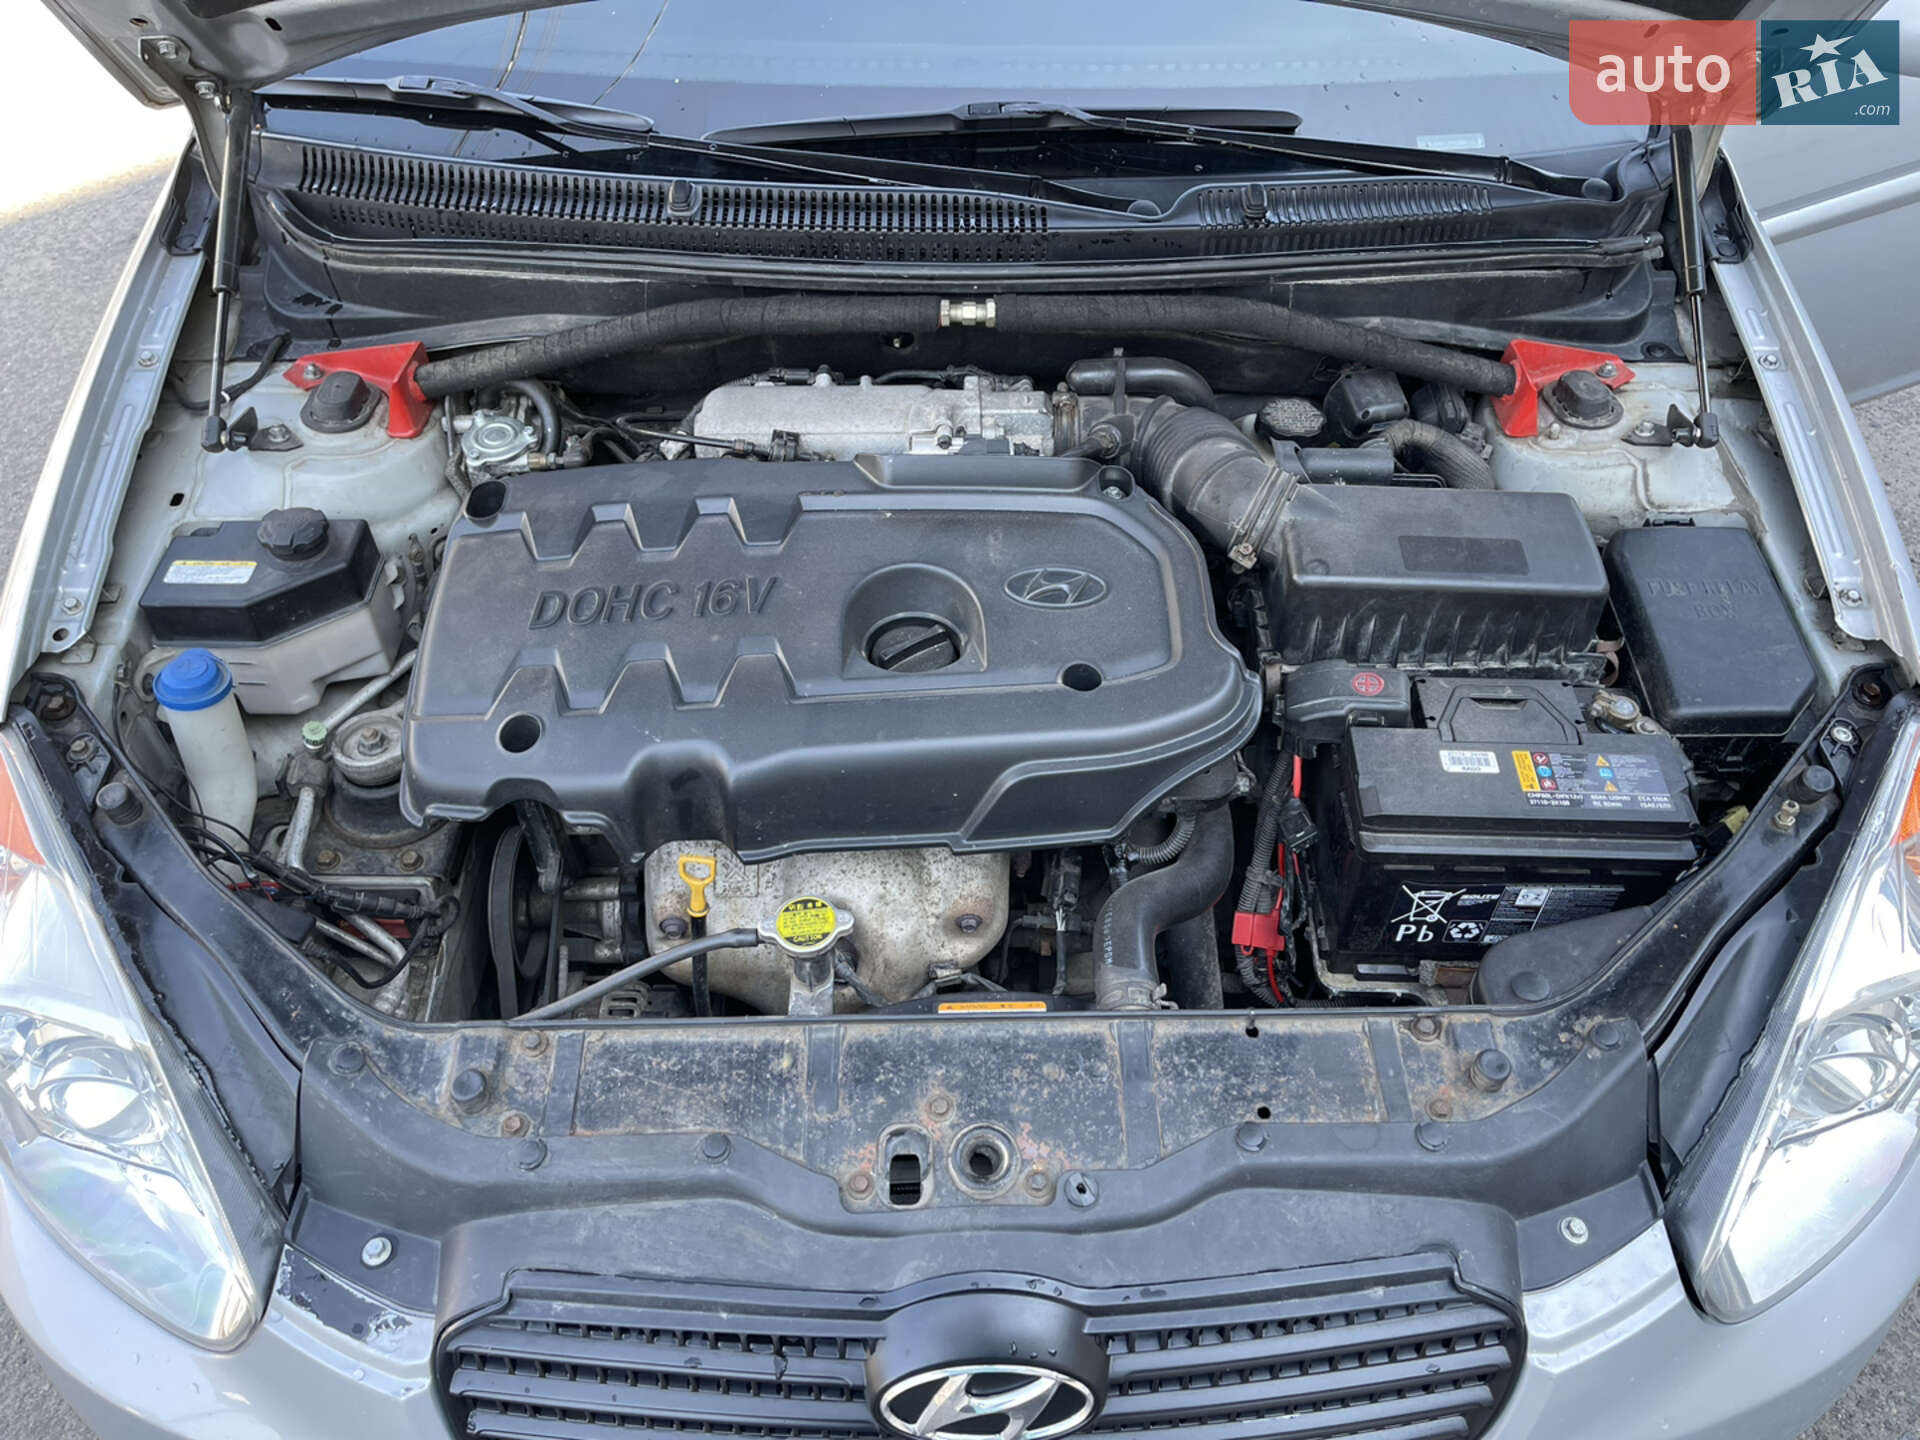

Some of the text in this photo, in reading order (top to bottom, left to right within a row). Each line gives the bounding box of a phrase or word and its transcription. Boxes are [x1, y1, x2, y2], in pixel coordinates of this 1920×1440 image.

[528, 576, 778, 630] DOHC 16V
[1395, 924, 1434, 942] Pb
